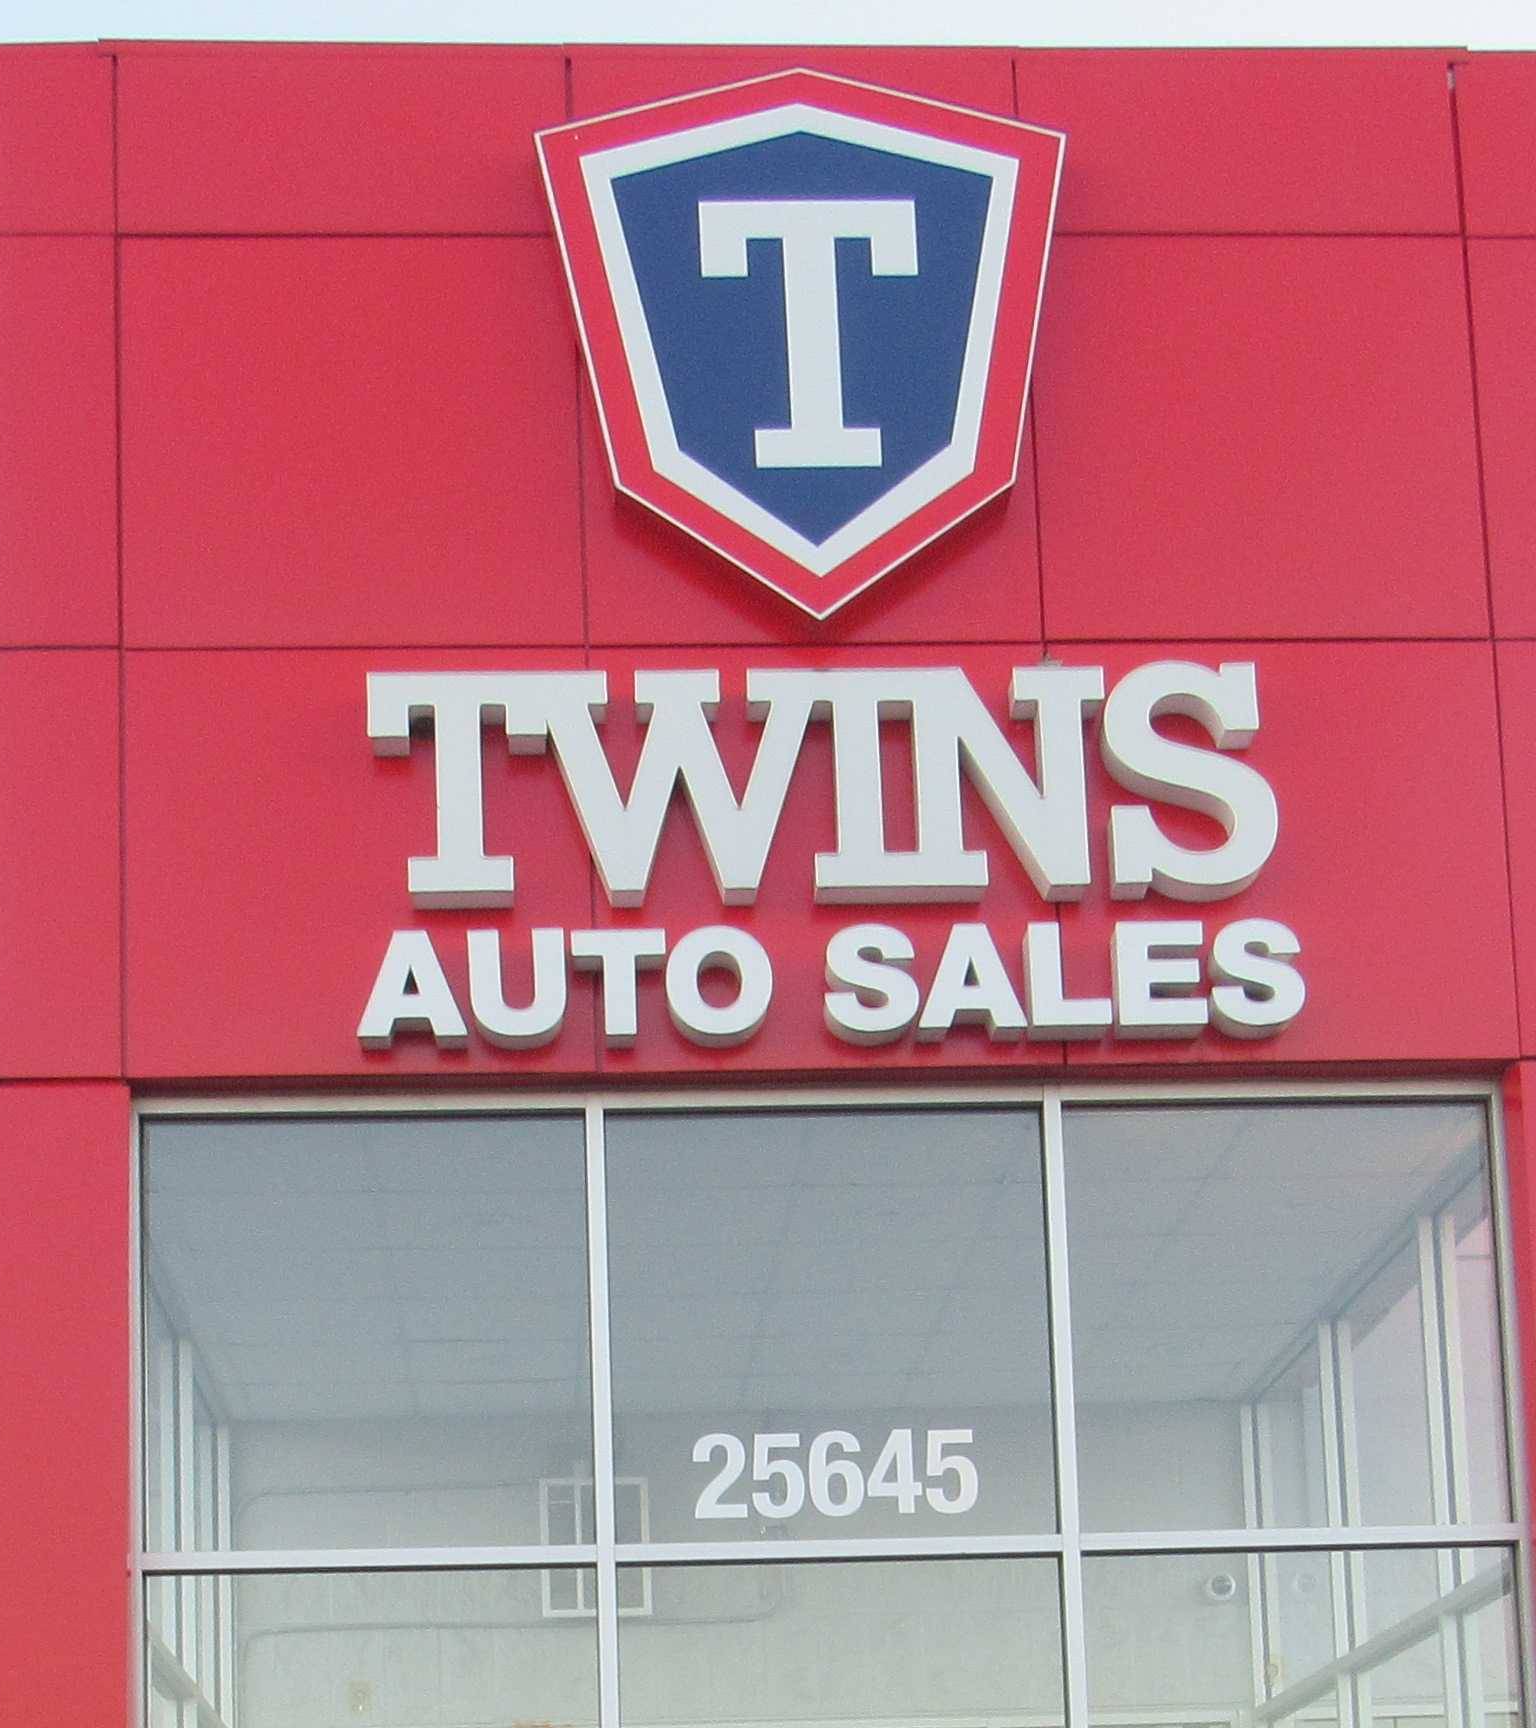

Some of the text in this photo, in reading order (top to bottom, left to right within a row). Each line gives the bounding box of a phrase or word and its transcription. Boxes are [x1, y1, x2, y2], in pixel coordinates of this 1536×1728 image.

[698, 200, 918, 467] T
[366, 660, 1278, 910] TWINS
[357, 918, 1306, 1051] AUTO SALES
[692, 1428, 978, 1519] 25645
